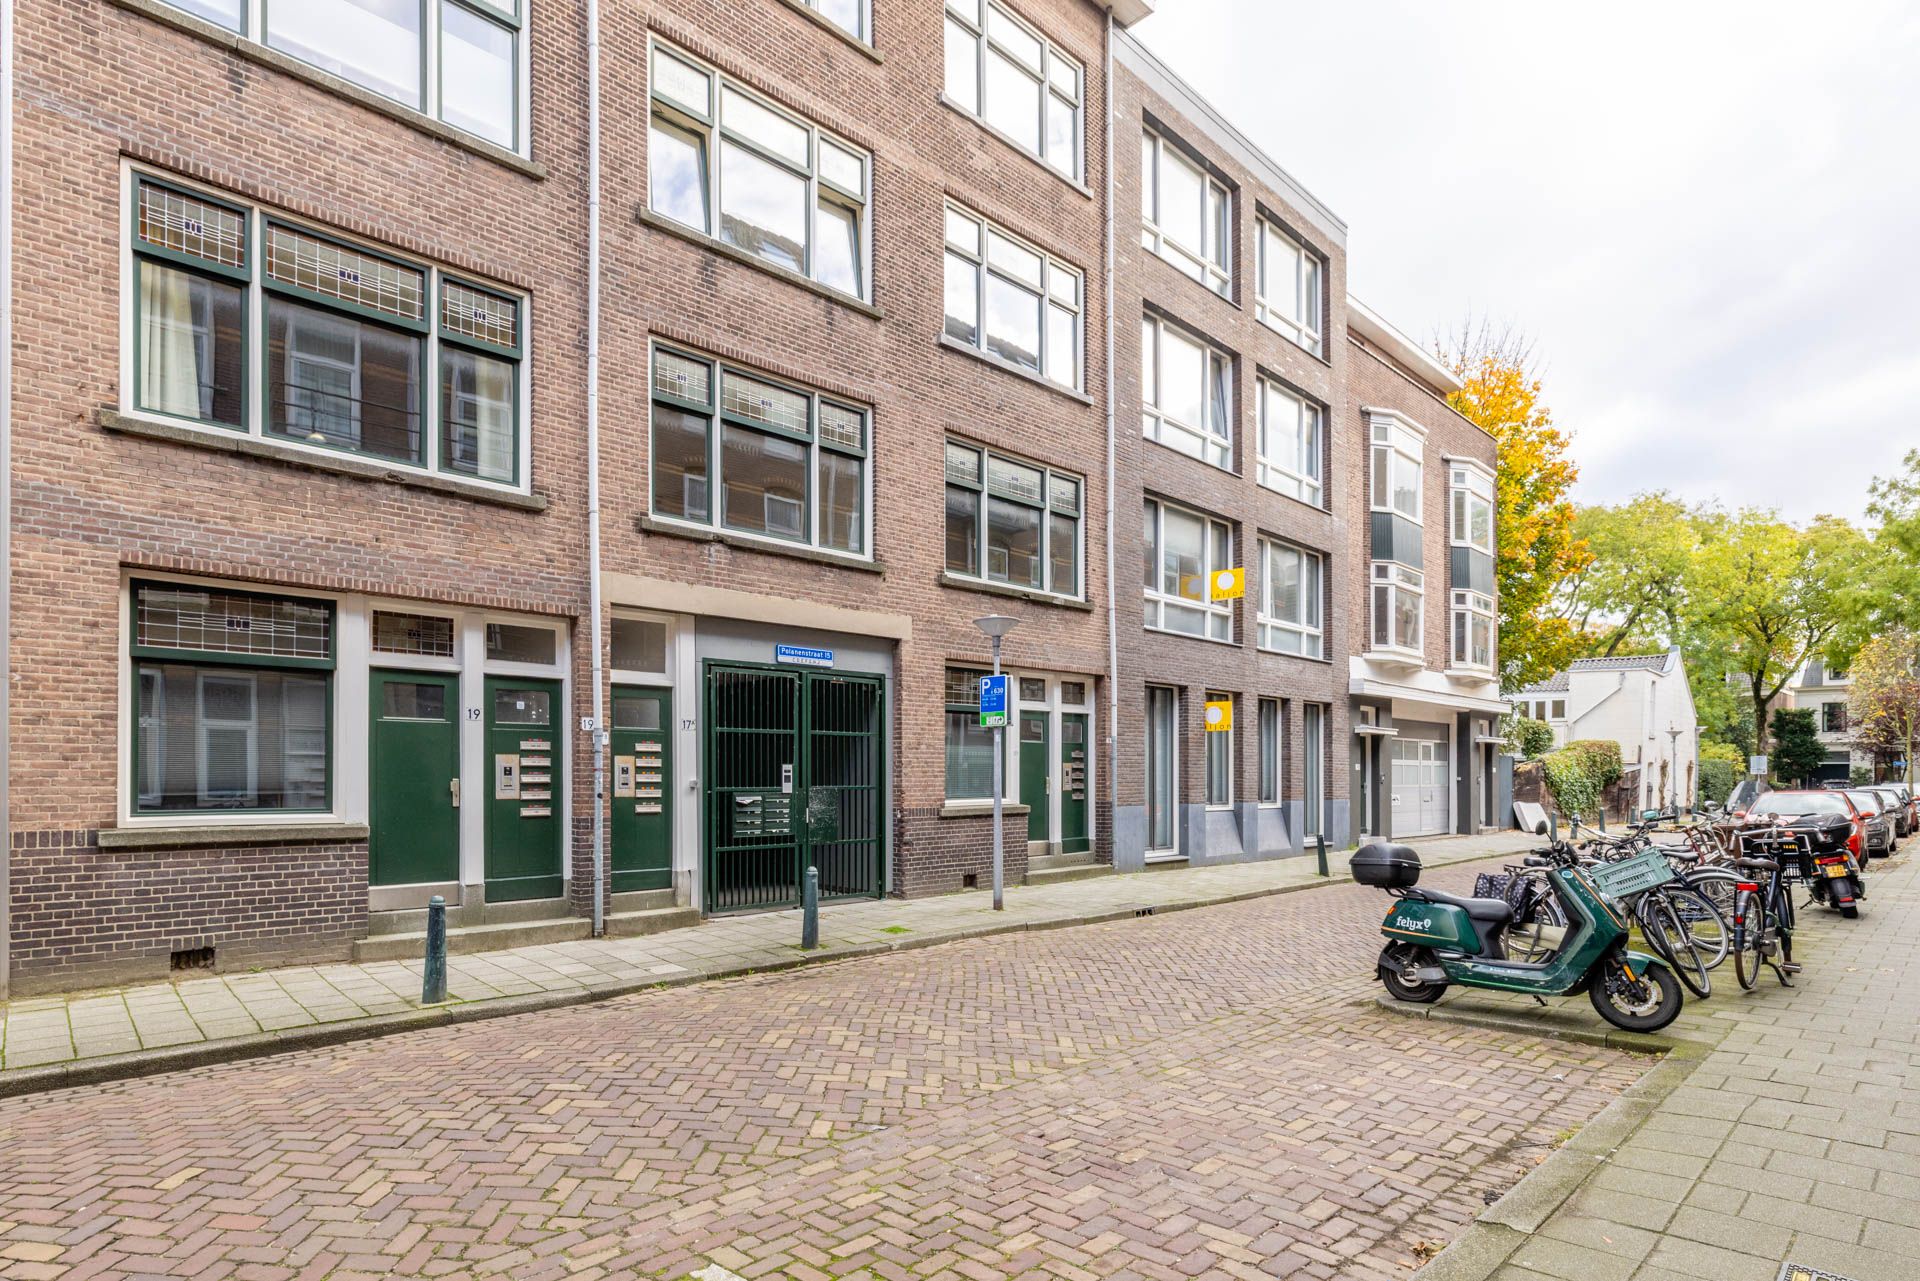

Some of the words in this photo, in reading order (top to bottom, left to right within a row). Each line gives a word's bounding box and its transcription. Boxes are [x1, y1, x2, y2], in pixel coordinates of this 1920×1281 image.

[824, 651, 831, 659] 15
[981, 679, 991, 695] P
[467, 708, 481, 720] 19
[583, 719, 594, 729] 19
[1396, 915, 1424, 931] felyx
